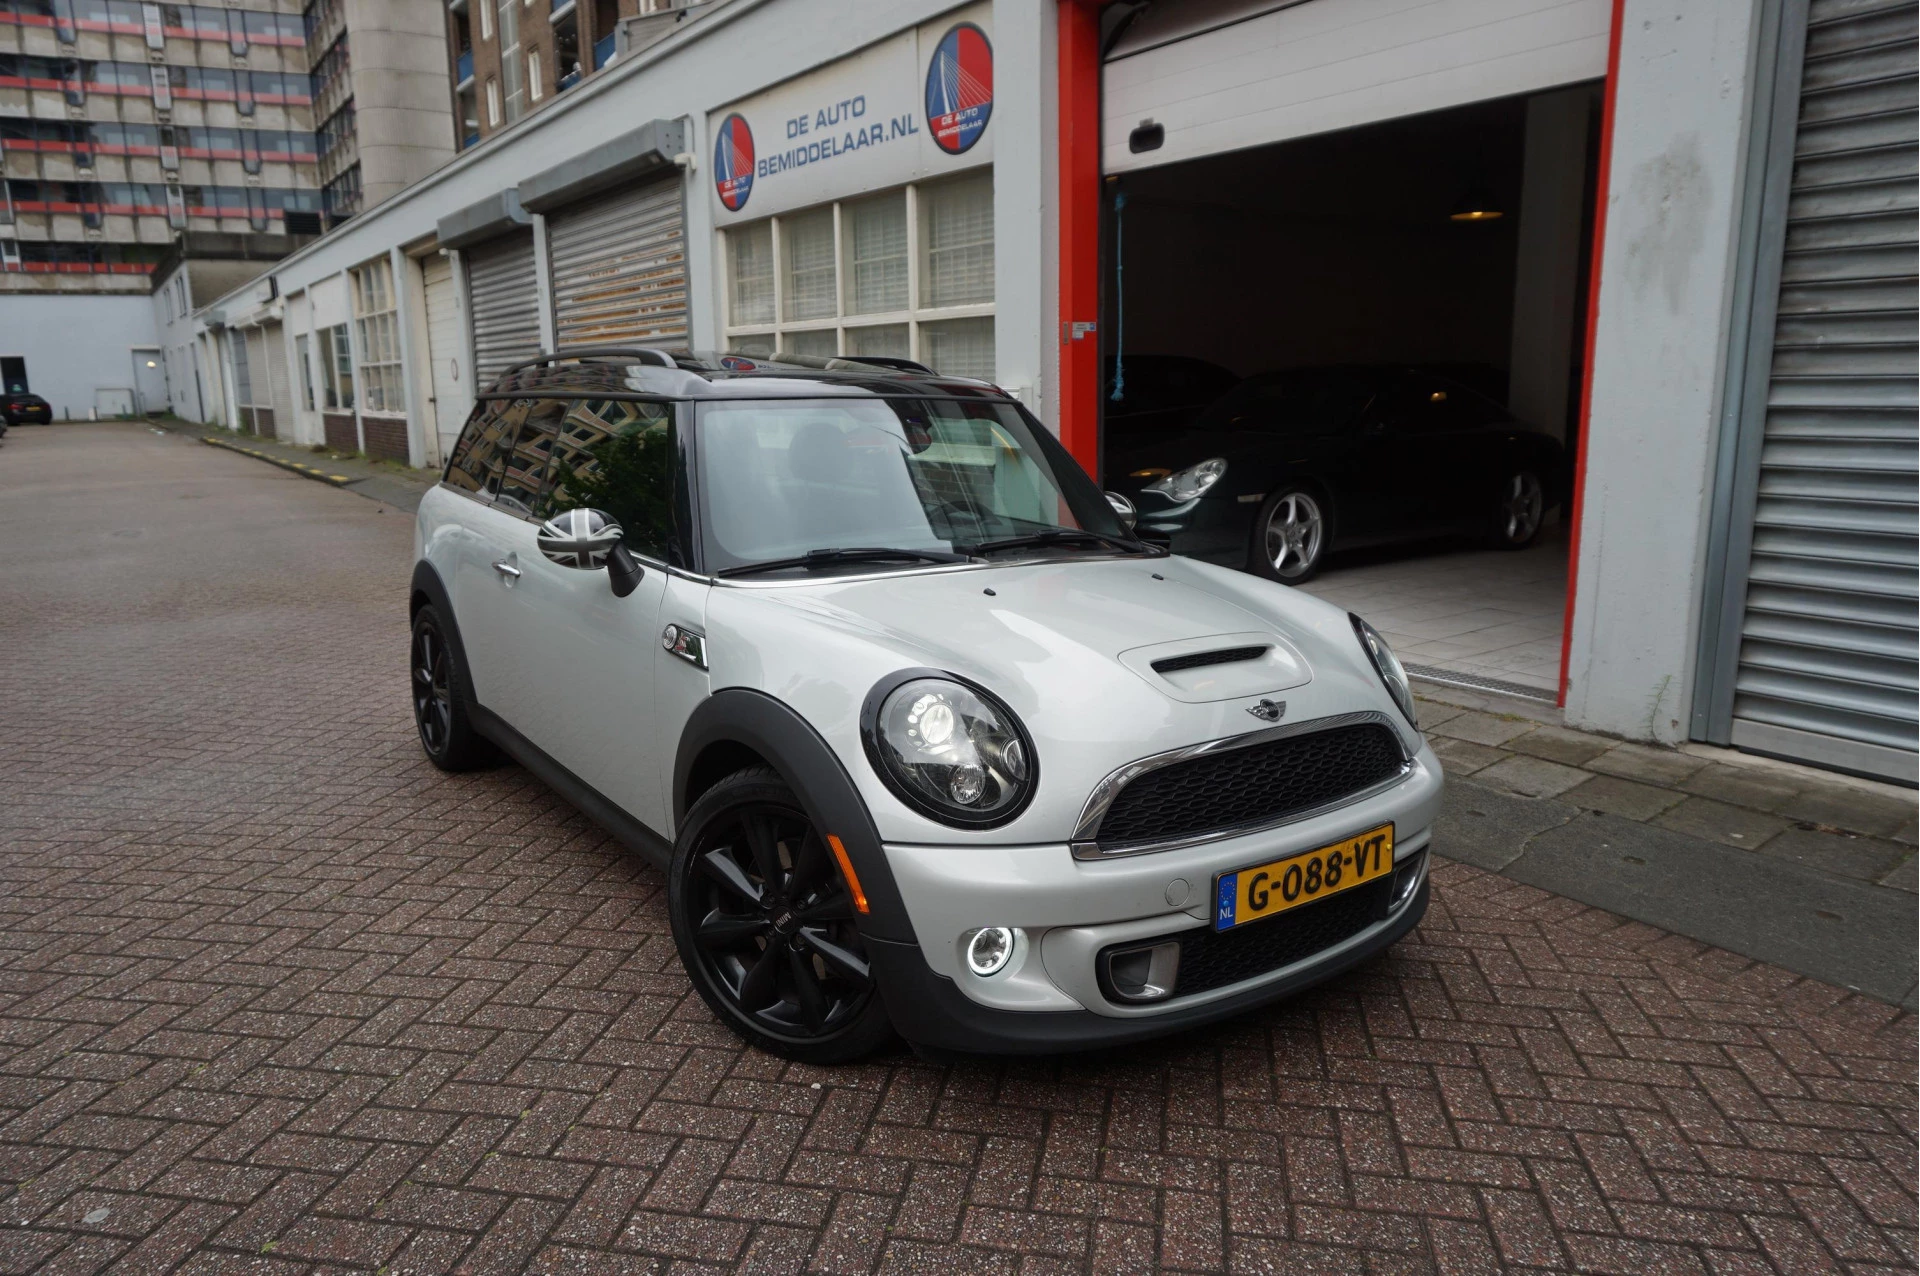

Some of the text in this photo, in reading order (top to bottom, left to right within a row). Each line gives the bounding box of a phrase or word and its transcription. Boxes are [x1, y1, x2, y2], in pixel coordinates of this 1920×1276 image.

[786, 94, 866, 139] DE AUTO
[941, 107, 979, 126] DE AUTO
[757, 113, 919, 178] BEMIDDELAAR.NL
[1248, 834, 1386, 911] G-088-VT
[1219, 907, 1234, 920] NL
